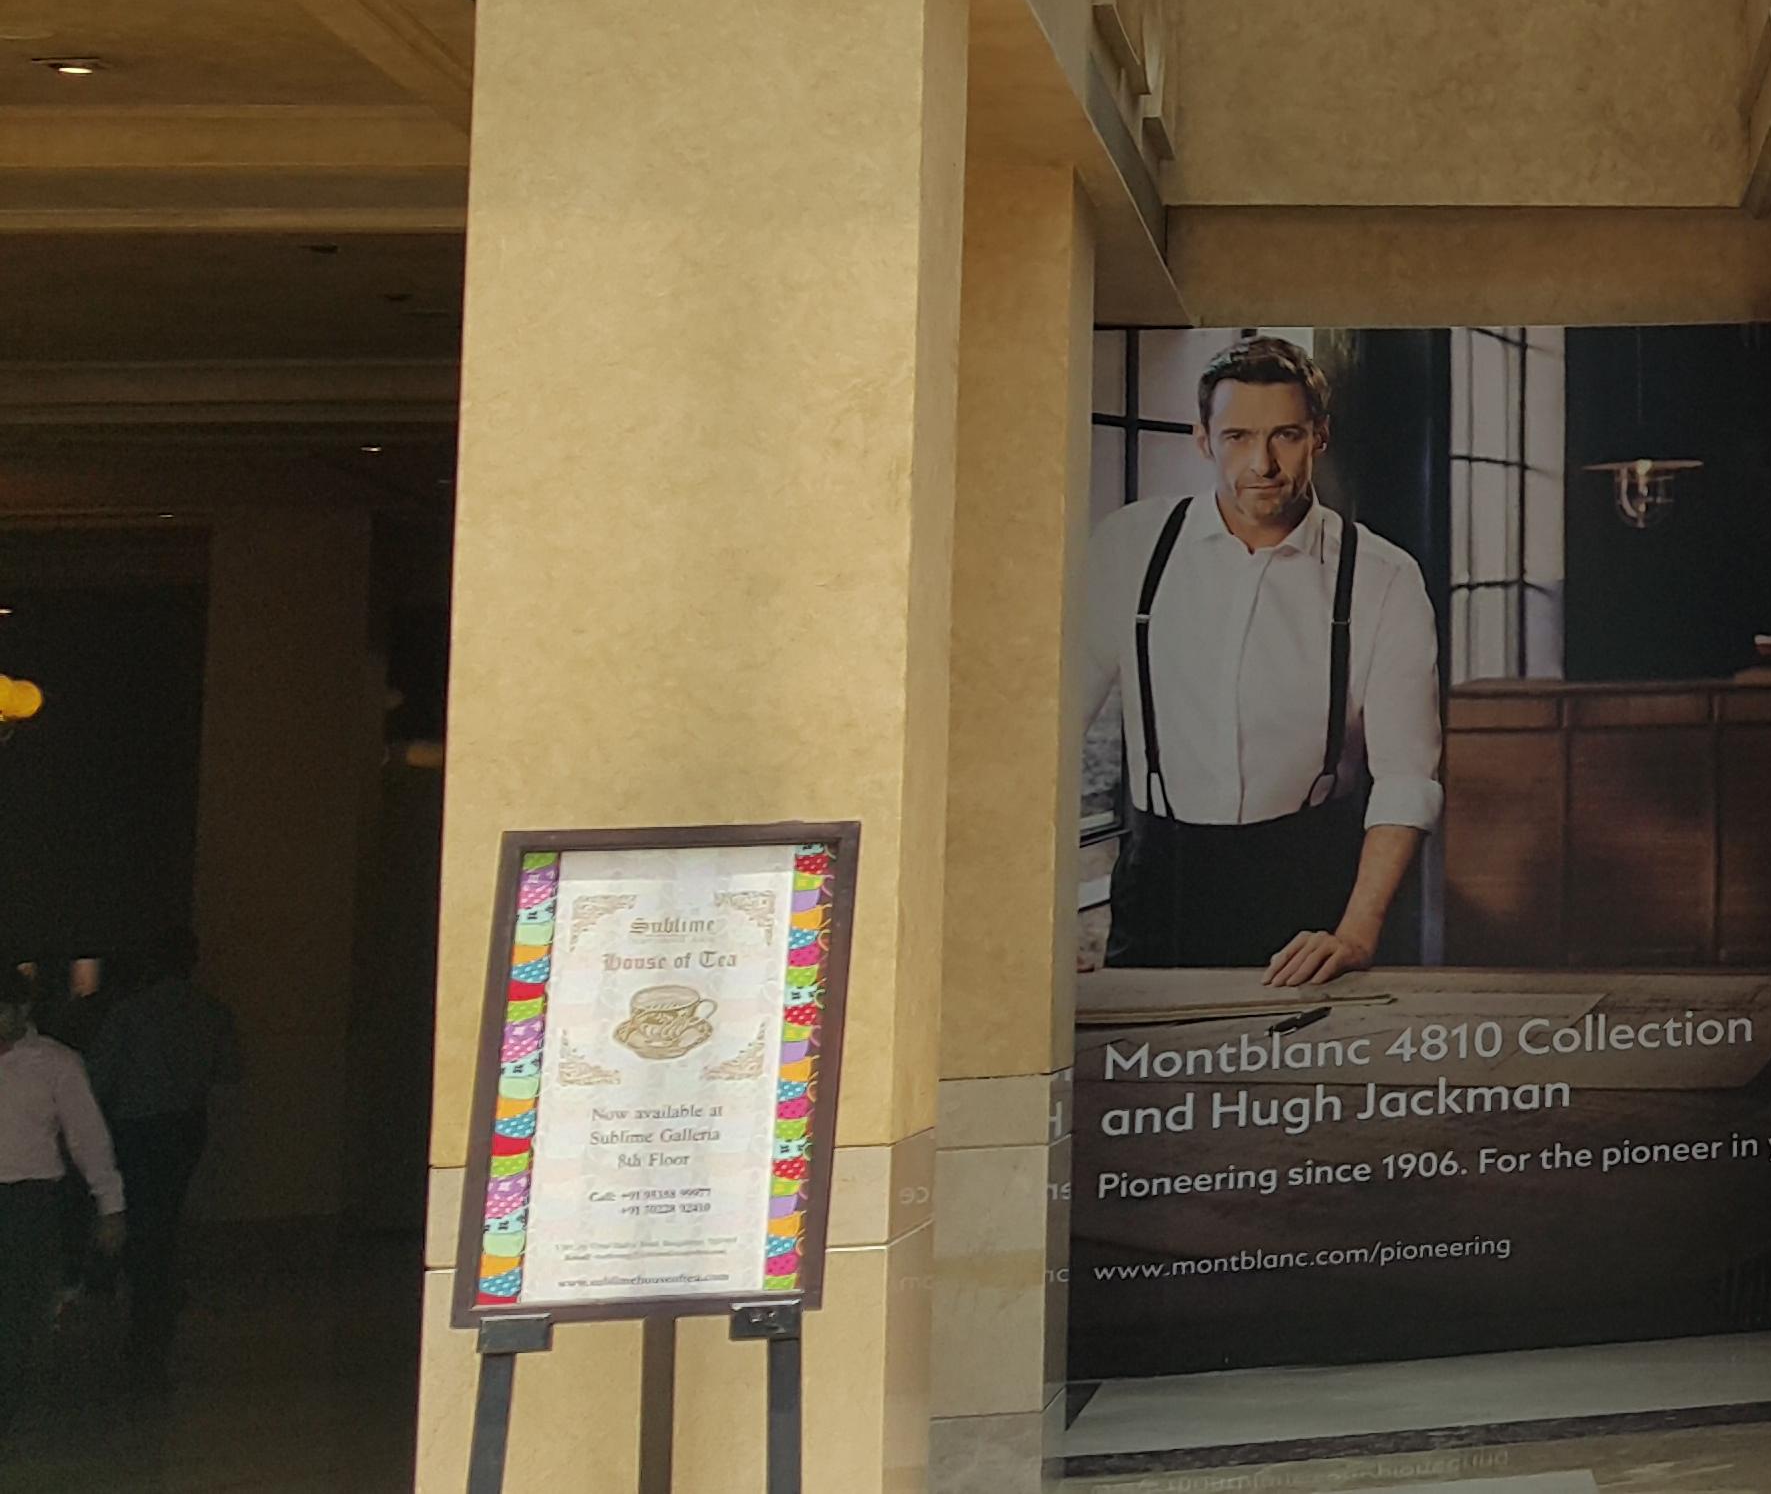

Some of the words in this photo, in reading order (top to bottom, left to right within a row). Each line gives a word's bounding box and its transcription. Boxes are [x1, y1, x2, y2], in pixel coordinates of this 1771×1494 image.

[629, 917, 717, 934] Sublime
[602, 953, 666, 971] House
[673, 952, 692, 969] of
[699, 950, 738, 968] Tea
[1103, 1032, 1372, 1082] Montblanc
[1385, 1020, 1503, 1064] 4810
[1518, 1010, 1753, 1060] Collection
[592, 1108, 629, 1122] Now
[634, 1104, 704, 1120] available
[709, 1105, 724, 1118] at
[1101, 1090, 1194, 1137] and
[1212, 1080, 1343, 1137] Hugh
[1357, 1073, 1571, 1121] Jackman
[590, 1130, 653, 1146] Sublime
[659, 1128, 720, 1143] Galleria
[617, 1153, 641, 1170] 8th
[648, 1152, 691, 1167] Floor
[1097, 1161, 1279, 1199] Pioneering
[1287, 1156, 1372, 1187] since
[1383, 1150, 1469, 1180] 1906.
[1478, 1146, 1529, 1175] For
[1538, 1141, 1594, 1172] the
[1602, 1135, 1722, 1173] pioneer
[1732, 1130, 1760, 1158] in
[1093, 1234, 1512, 1282] www.montblanc.com/pioneering
